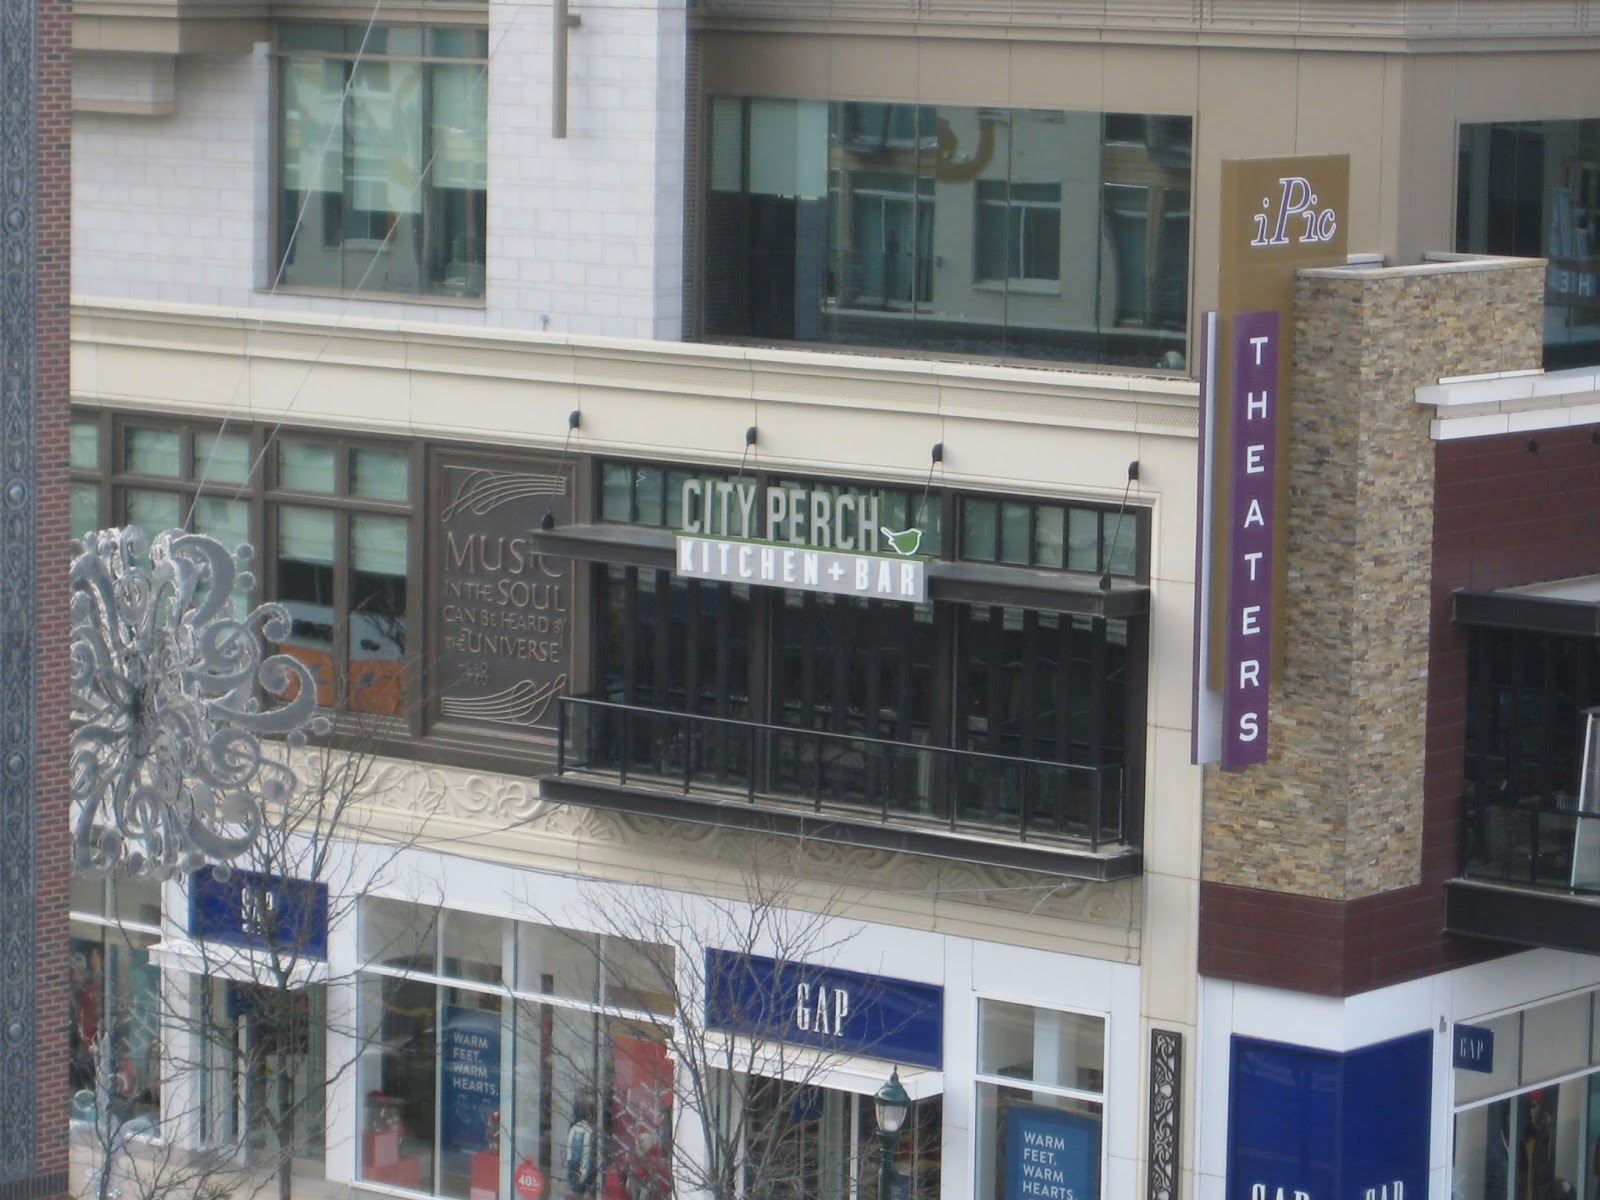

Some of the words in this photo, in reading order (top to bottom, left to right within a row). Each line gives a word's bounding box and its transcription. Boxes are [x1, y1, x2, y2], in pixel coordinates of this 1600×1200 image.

[1251, 177, 1336, 246] iPic
[682, 479, 756, 538] CITY
[767, 486, 880, 553] PERCH
[1239, 336, 1268, 742] THEATERS
[465, 582, 493, 602] THE
[498, 580, 566, 611] SOUL
[444, 605, 476, 622] CAN
[501, 611, 549, 633] HEARD
[462, 628, 560, 663] UNIVERSE
[796, 982, 848, 1037] GAP
[453, 1032, 488, 1049] WARM
[1460, 1037, 1484, 1060] GAP
[453, 1047, 482, 1063] FEET.
[453, 1062, 488, 1079] WARM
[453, 1078, 499, 1096] HEARTS.
[1024, 1131, 1065, 1150] WARM
[1024, 1148, 1057, 1165] FEET.
[1023, 1164, 1064, 1183] WARM
